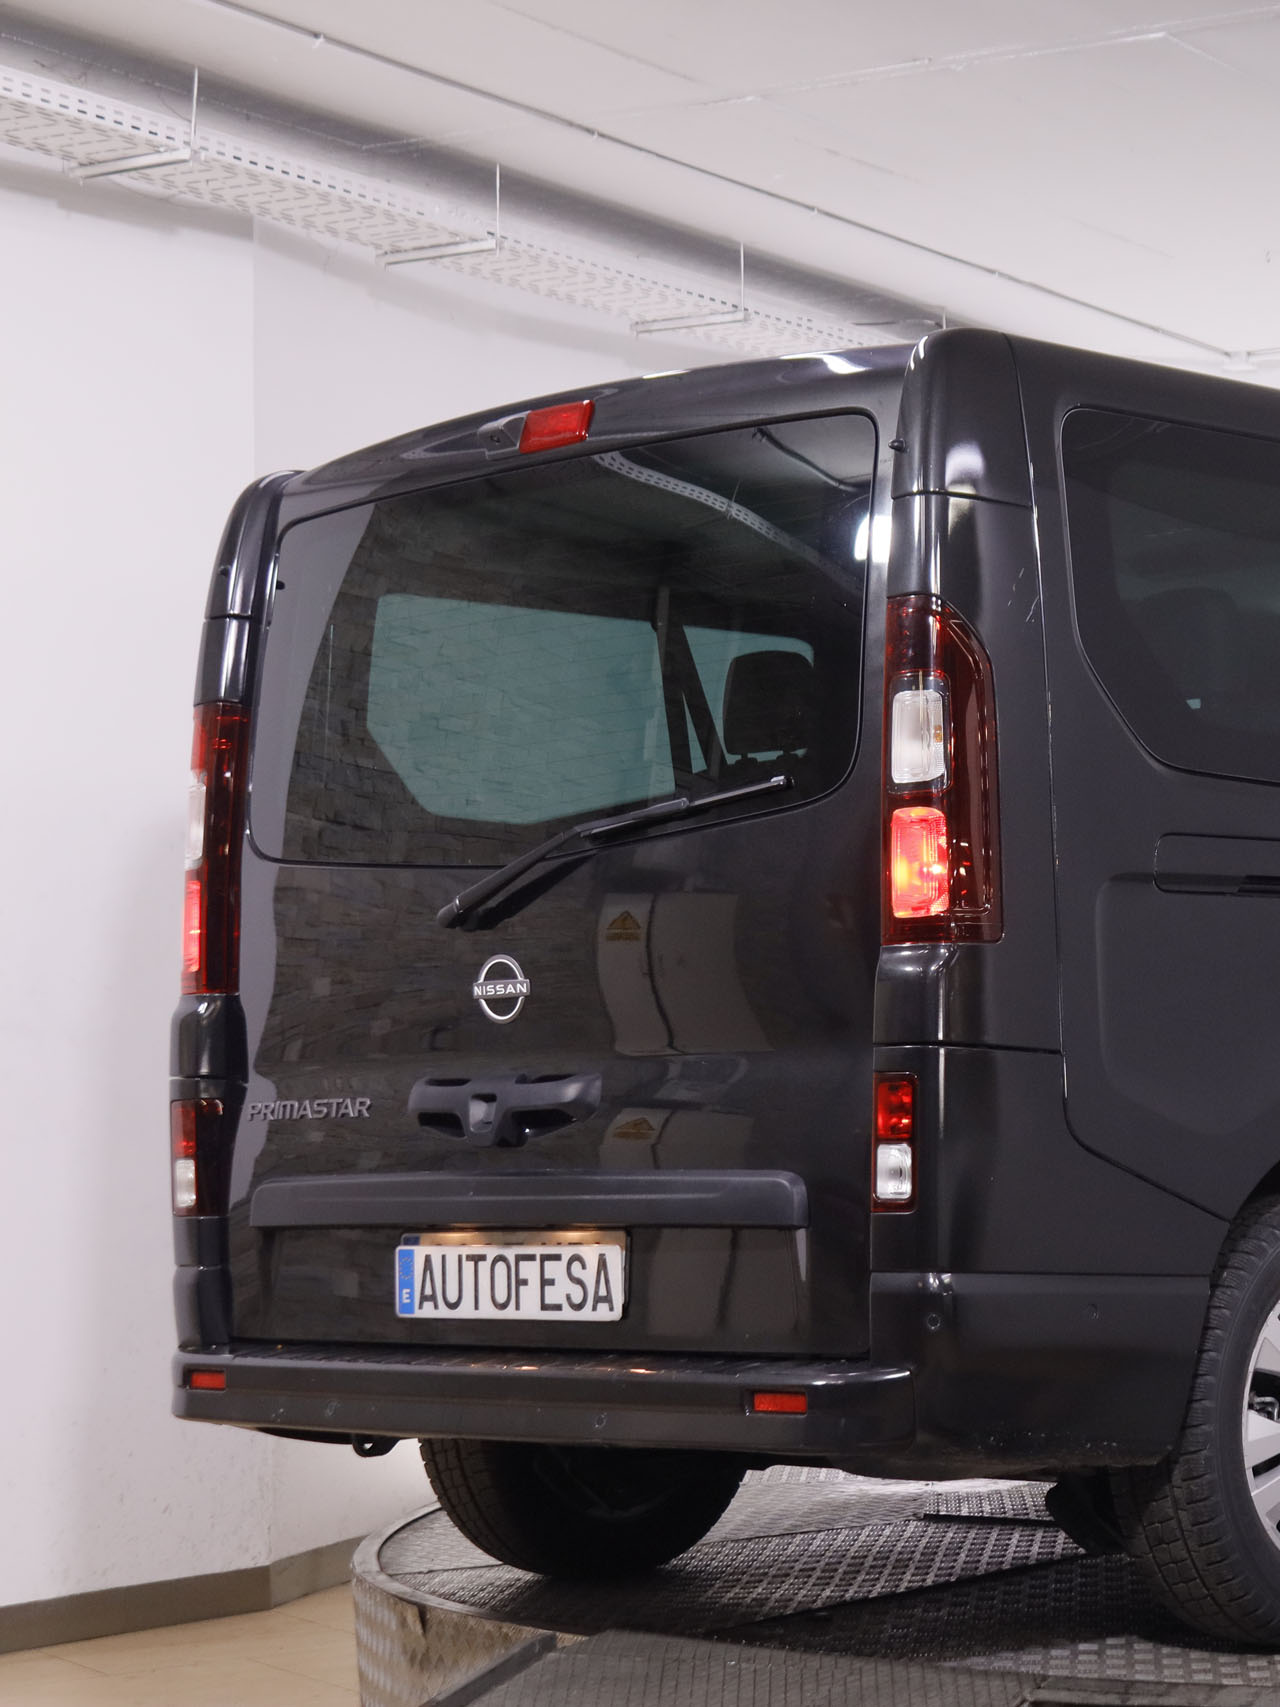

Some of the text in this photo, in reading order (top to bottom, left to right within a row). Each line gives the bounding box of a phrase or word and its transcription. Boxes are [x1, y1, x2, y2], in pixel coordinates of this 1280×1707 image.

[473, 983, 527, 996] NISSAN
[248, 1098, 371, 1121] PRIMASTAR
[402, 1253, 614, 1312] E AUTOFESA
